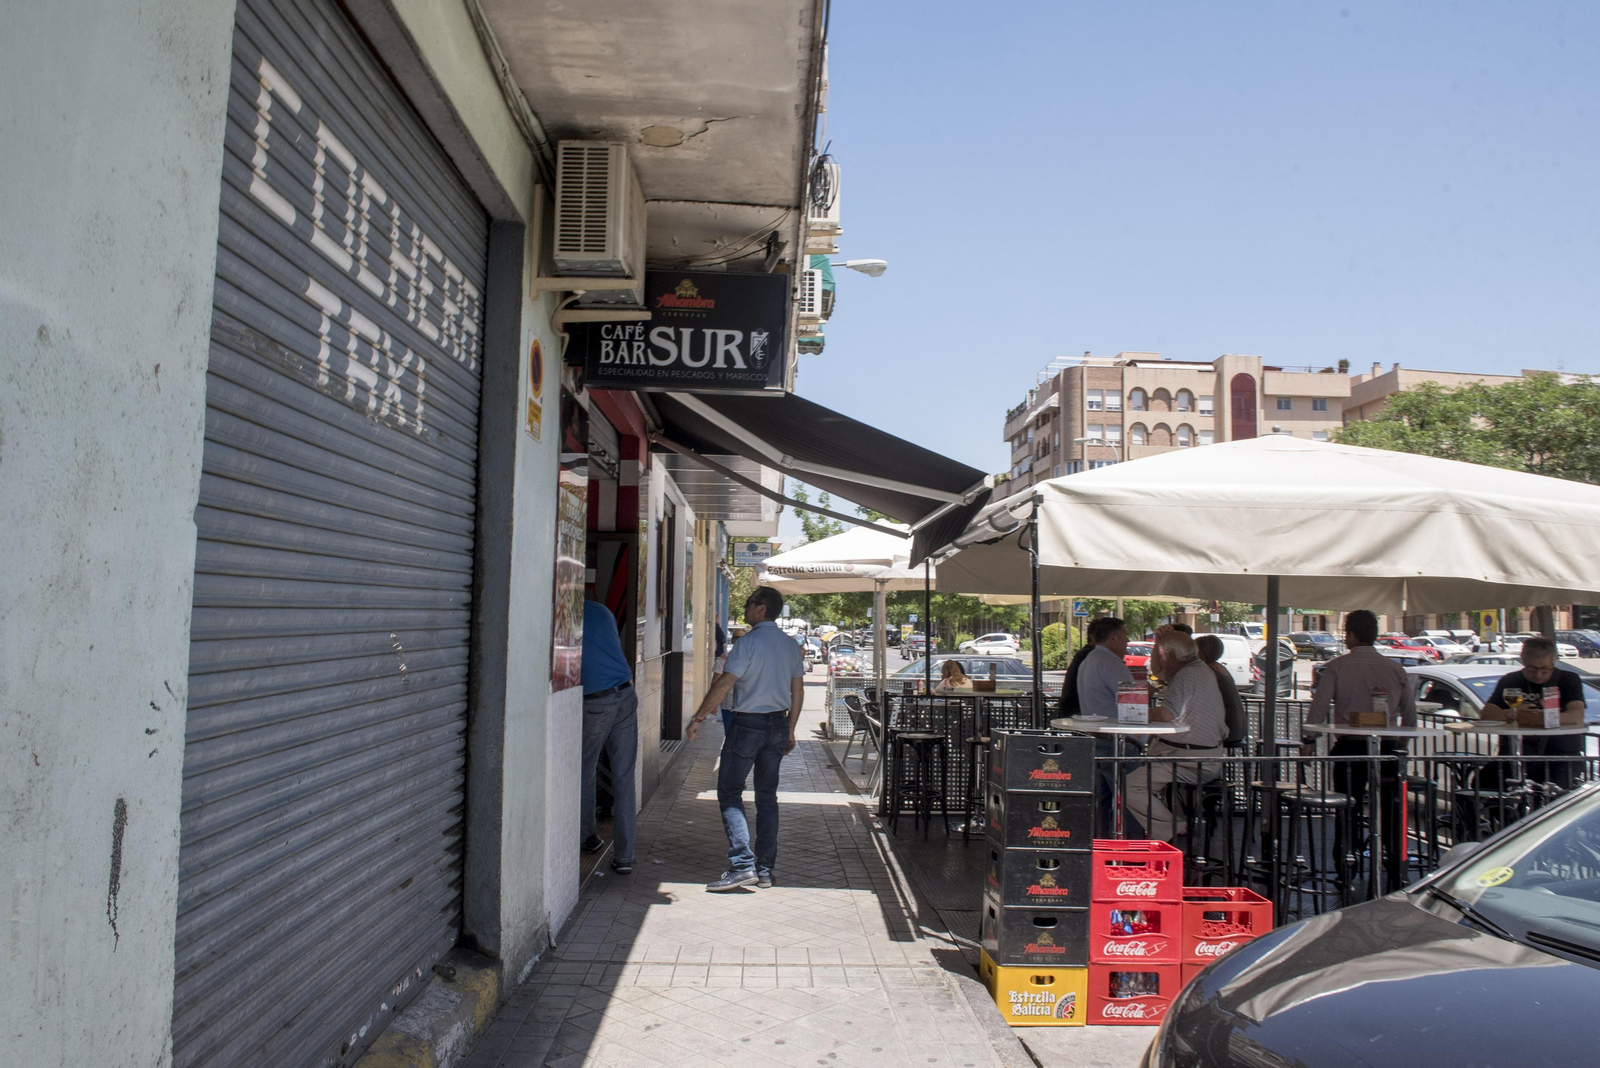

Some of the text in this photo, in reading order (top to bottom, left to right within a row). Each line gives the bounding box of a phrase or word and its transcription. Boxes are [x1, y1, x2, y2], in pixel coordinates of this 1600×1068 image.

[656, 293, 715, 309] Alhambra
[601, 322, 645, 341] CAFÉ
[600, 341, 646, 365] BAR
[647, 326, 747, 370] SUR
[305, 277, 427, 435] TAXI
[598, 367, 654, 377] ESPECIALIDAD
[657, 370, 669, 378] EN
[671, 371, 715, 380] PESCADOS
[726, 373, 769, 382] MARISCOS
[767, 565, 842, 575] Estrella Galicia
[1029, 769, 1071, 780] Alhambra
[1027, 826, 1070, 838] Alhambra
[1026, 885, 1068, 896] Alhambra
[1116, 881, 1158, 896] Coca-Cola
[1023, 943, 1066, 954] Alhambra
[1103, 941, 1148, 956] Coca-Cola
[1008, 990, 1056, 1003] Estrella
[1011, 1002, 1051, 1016] Galicia
[1102, 1002, 1147, 1018] Coca-Cola
